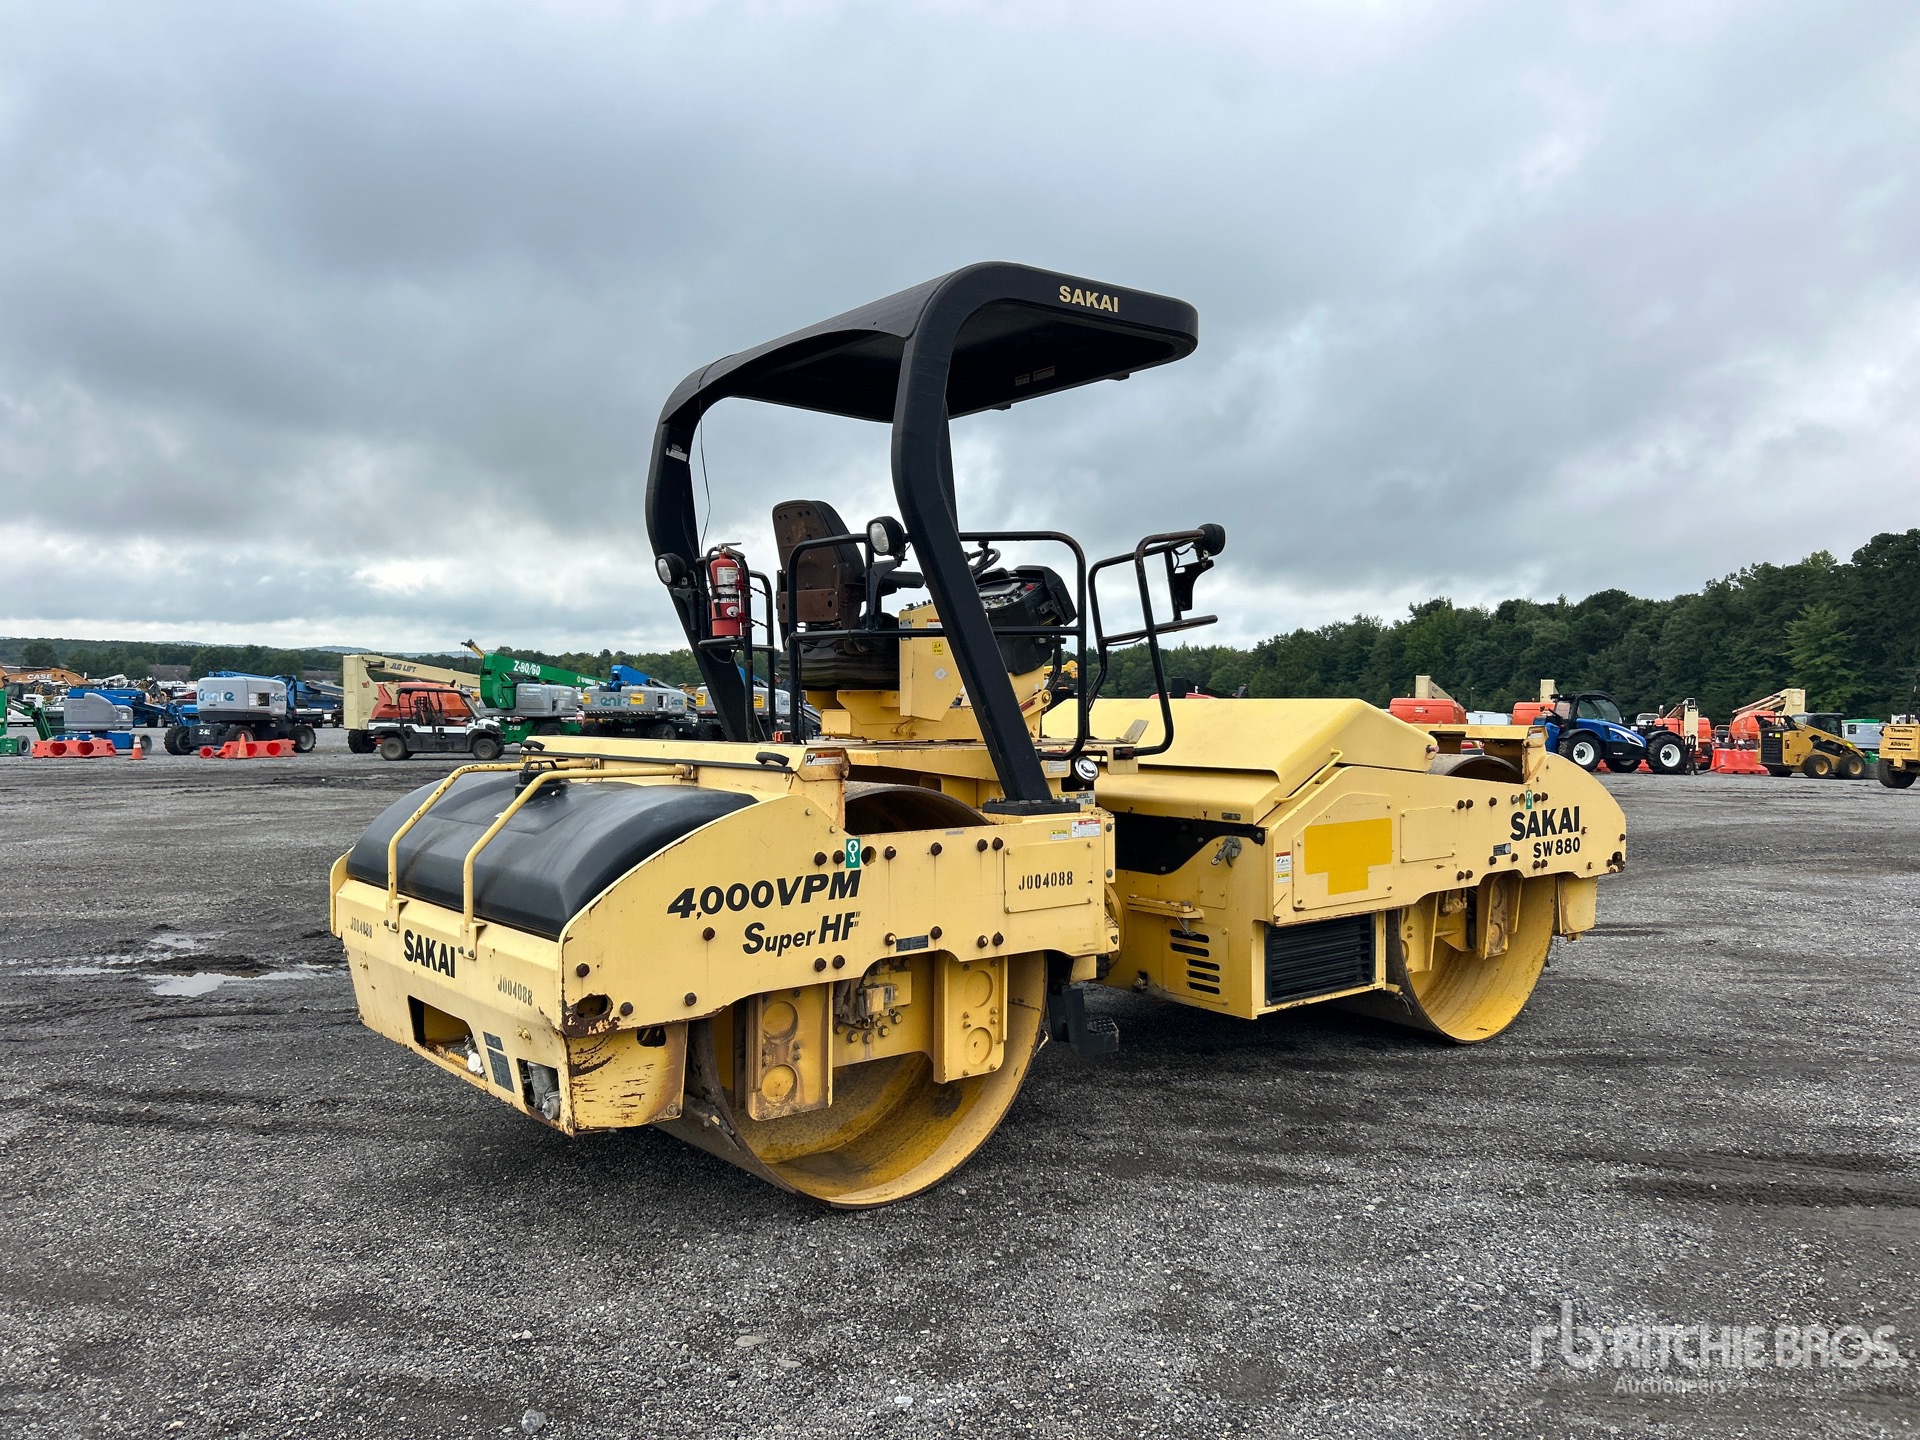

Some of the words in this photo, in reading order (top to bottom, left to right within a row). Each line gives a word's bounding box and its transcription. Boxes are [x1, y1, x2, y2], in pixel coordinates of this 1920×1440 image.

[1059, 285, 1119, 313] SAKAI
[198, 688, 235, 702] Genie
[1510, 806, 1580, 841] SAKAI
[667, 869, 862, 920] 4,000VPM
[1018, 870, 1074, 891] J004088
[403, 929, 456, 978] SAKAI
[742, 922, 817, 957] Super
[497, 974, 533, 1006] J004088
